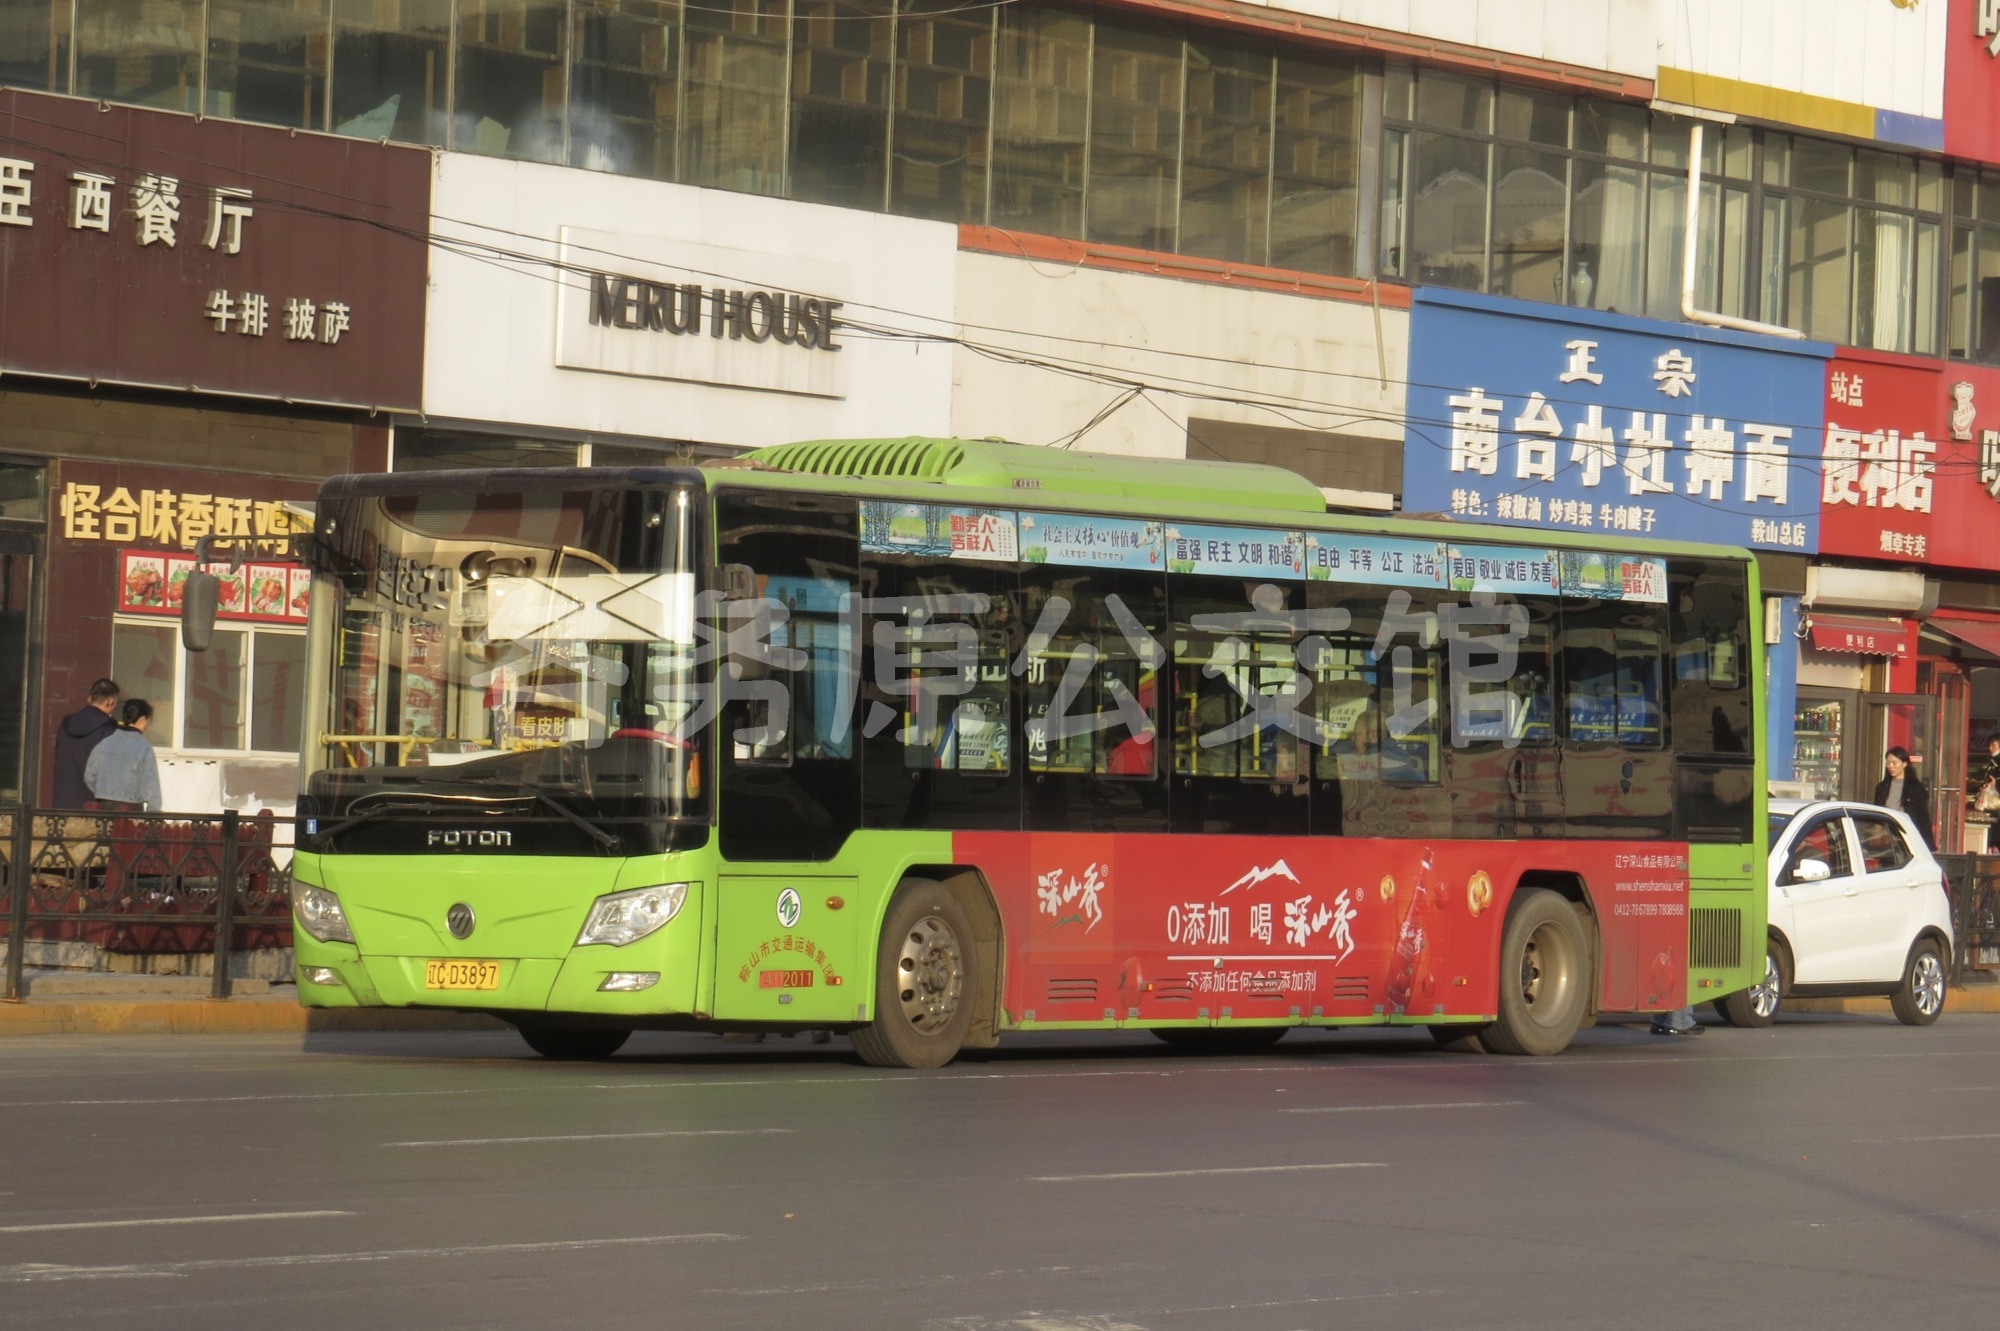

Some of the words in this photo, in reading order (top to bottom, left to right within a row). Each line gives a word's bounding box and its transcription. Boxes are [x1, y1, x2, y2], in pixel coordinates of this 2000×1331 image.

[205, 289, 268, 336] 牛排
[284, 298, 350, 344] 披萨
[588, 272, 702, 336] MERUI
[710, 288, 844, 352] HOUSE
[1559, 340, 1696, 397] 正宗
[1830, 372, 1864, 407] 站点
[1822, 421, 1937, 514] 便利店
[60, 482, 316, 556] 怪合味香酥鸡
[950, 515, 995, 534] 勤劳人
[1497, 493, 1542, 522] 辣椒油
[1549, 498, 1593, 527] 炒鸡架
[1599, 503, 1656, 532] 牛肉腱子
[951, 533, 995, 552] 吉祥人
[1043, 523, 1140, 549] 社会主义核心价值观
[1751, 518, 1806, 547] 鞍山总店
[1880, 530, 1926, 558] 烟草专卖
[1176, 538, 1202, 561] 富强
[1207, 541, 1232, 563] 民主
[1238, 542, 1263, 565] 文明
[1268, 544, 1293, 567] 和谐
[1318, 546, 1340, 569] 自由
[1350, 549, 1372, 571] 平等
[1381, 551, 1404, 573] 公正
[1412, 553, 1434, 576] 法治
[1453, 558, 1475, 579] 爱国
[1479, 559, 1501, 580] 敬业
[1505, 560, 1527, 582] 诚信
[1530, 561, 1551, 584] 友善
[1622, 579, 1652, 595] 吉祥人
[1846, 634, 1875, 649] 便利店
[427, 830, 512, 846] FOTON
[1615, 854, 1683, 869] 辽宁深山食品有限公司
[1615, 880, 1684, 892] www.shenshanxiu.net
[1167, 902, 1230, 945] 0添加
[1250, 903, 1272, 945] 喝
[739, 935, 835, 984] 鞍山市交通运输集团
[1186, 970, 1317, 993] 不添加任何食品添加剂
